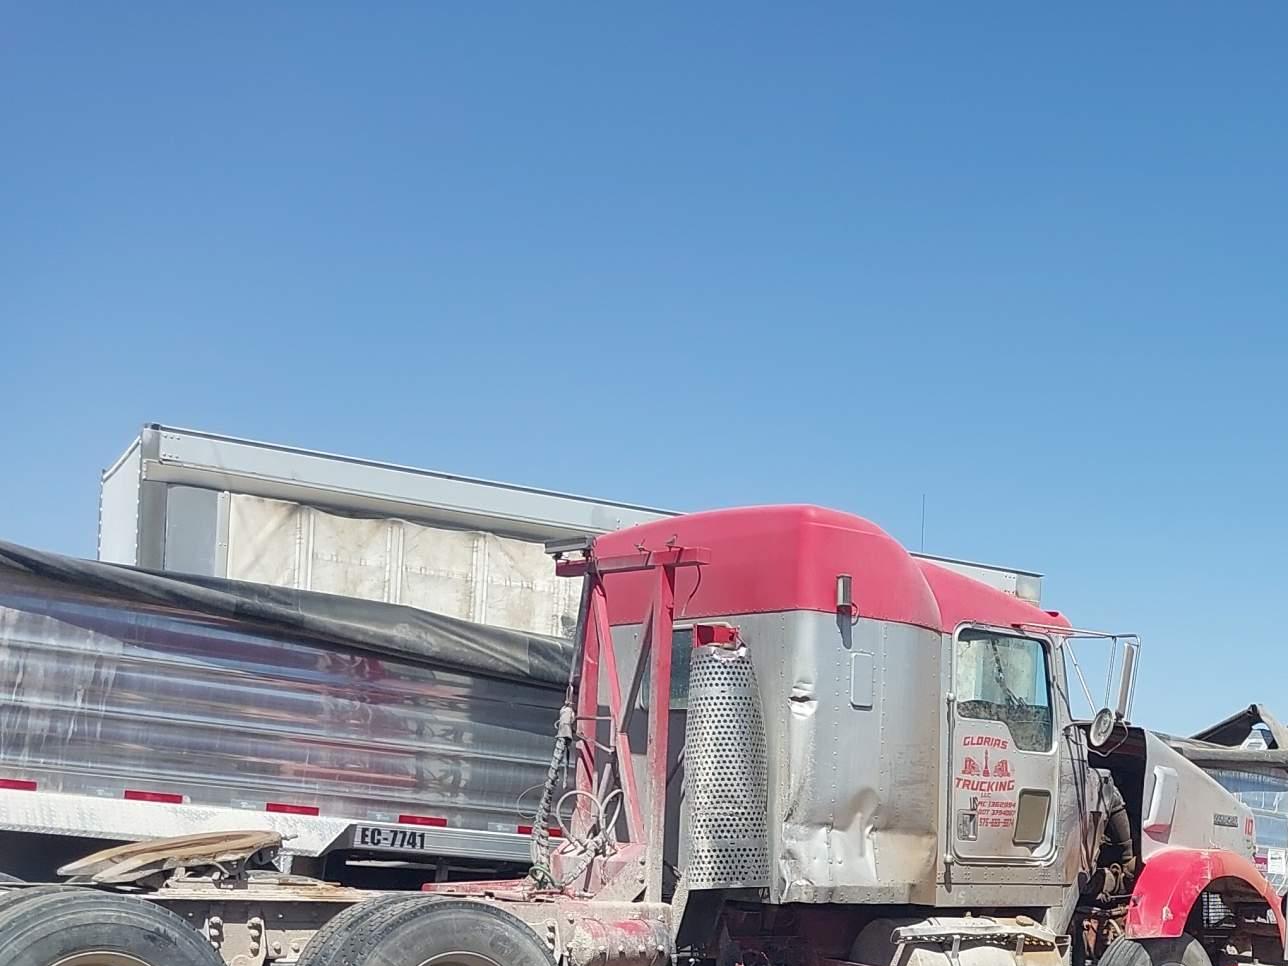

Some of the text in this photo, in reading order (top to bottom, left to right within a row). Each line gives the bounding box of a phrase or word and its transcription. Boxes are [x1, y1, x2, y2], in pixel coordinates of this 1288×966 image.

[963, 736, 1008, 749] GLORIAS
[955, 777, 1015, 792] TRUCKING
[360, 827, 425, 850] EC-7741
